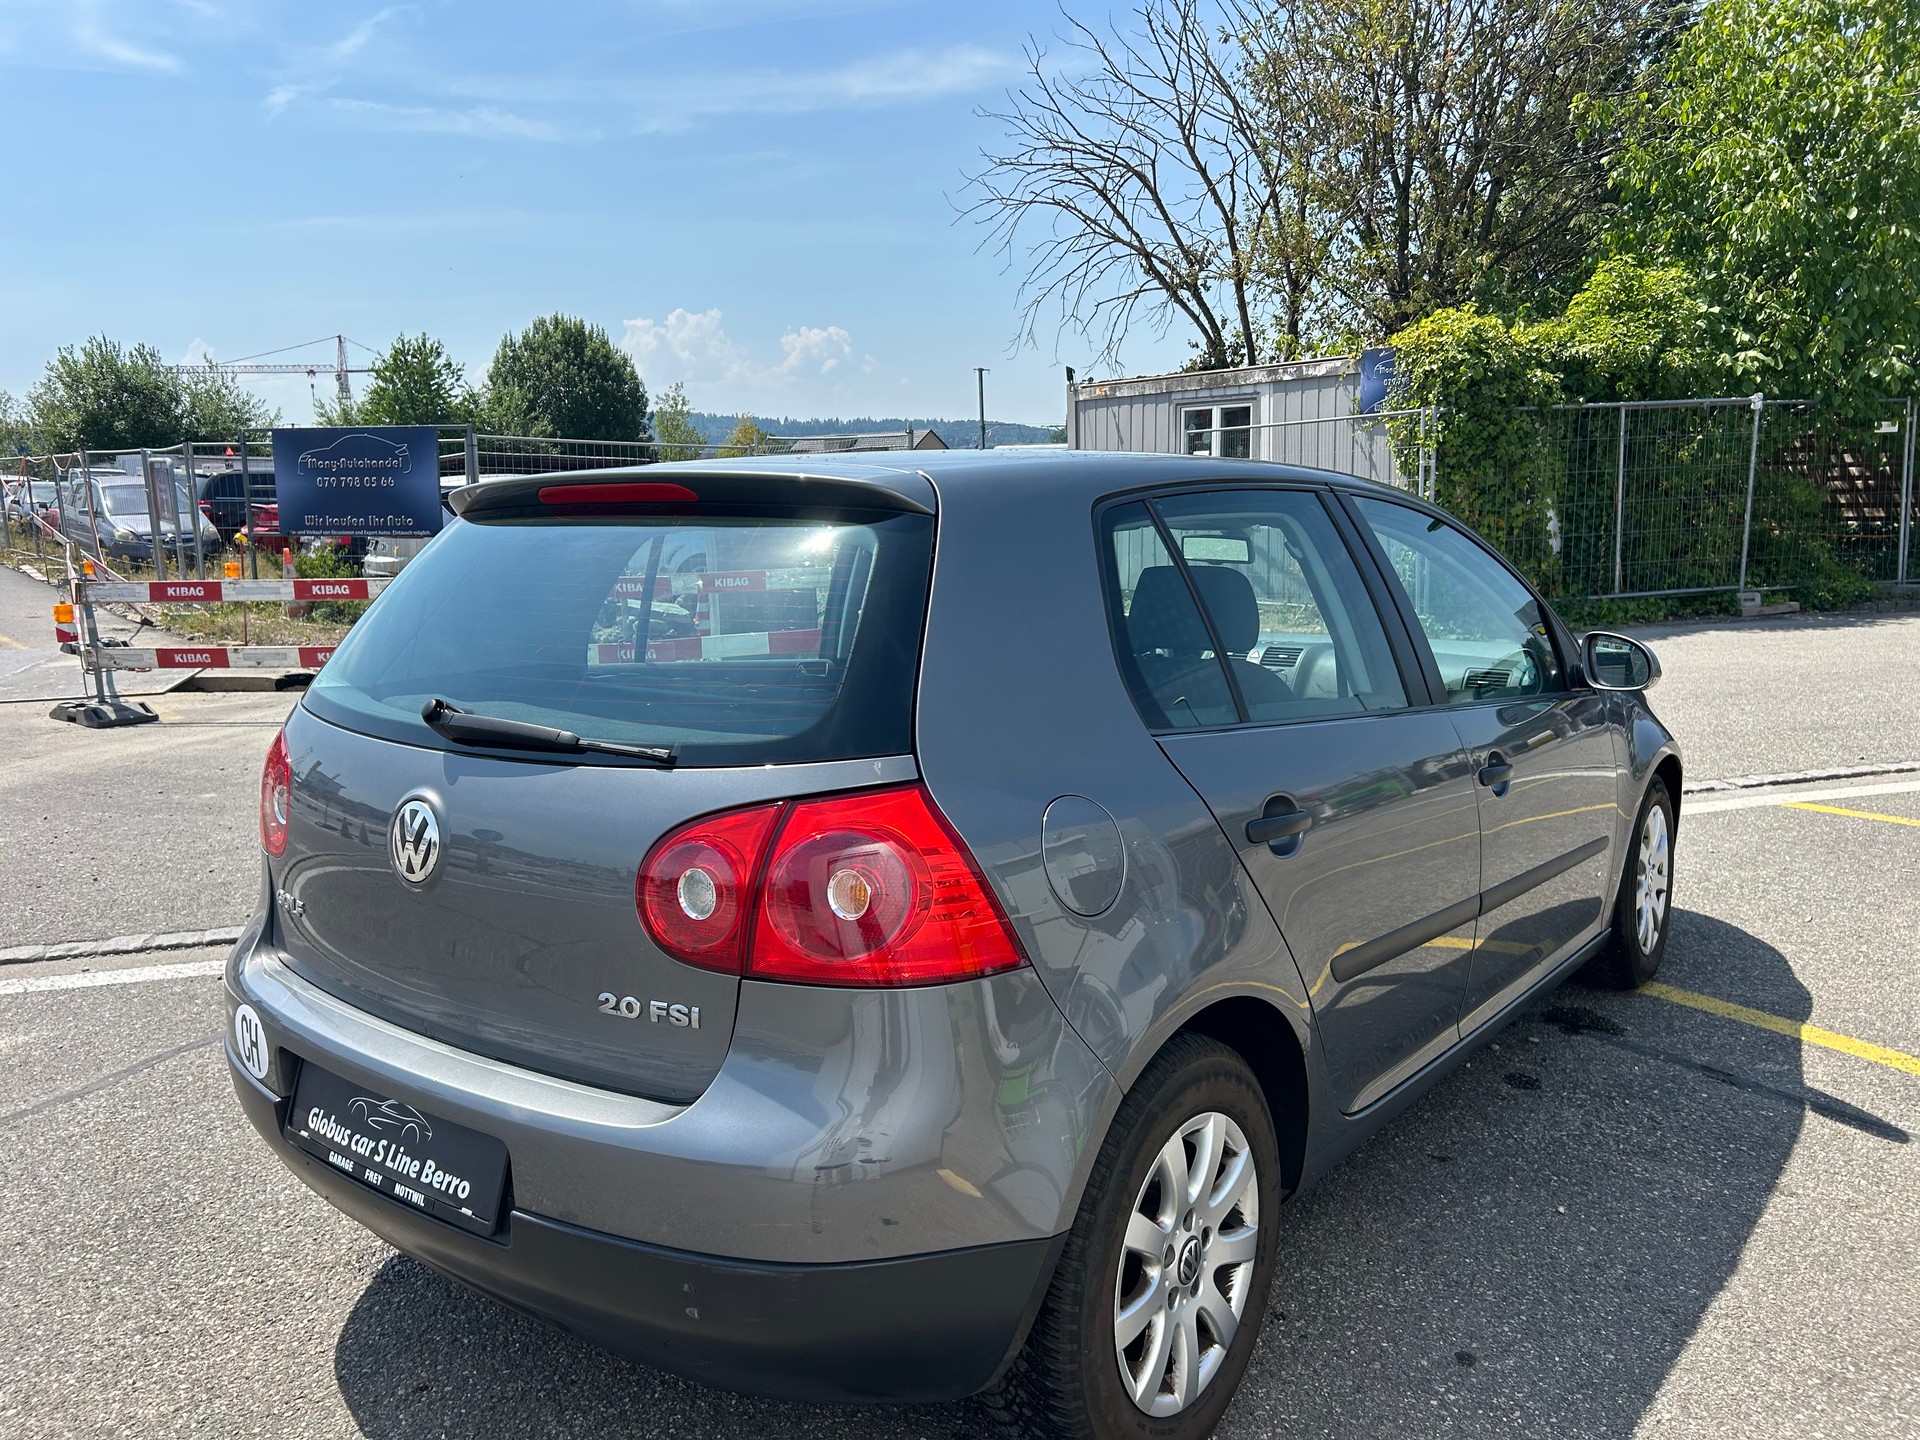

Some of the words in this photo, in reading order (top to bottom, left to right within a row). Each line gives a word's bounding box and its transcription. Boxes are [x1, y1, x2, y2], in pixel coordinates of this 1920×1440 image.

[307, 457, 402, 472] Mony-Autohandel
[316, 476, 336, 488] 079
[341, 476, 361, 488] 798
[364, 476, 377, 488] 05
[380, 476, 395, 488] 66
[304, 514, 323, 527] Wir
[325, 514, 365, 527] kaufen
[368, 514, 384, 527] Ihr
[387, 514, 414, 527] Auto
[615, 582, 644, 593] KIBA
[714, 576, 749, 588] KIBAG
[167, 586, 205, 597] KIBAG
[311, 584, 350, 596] KIBAG
[173, 652, 212, 664] KIBAG
[649, 999, 701, 1030] FSI
[240, 1013, 262, 1073] CH
[307, 1106, 353, 1146] Globus
[350, 1132, 376, 1158] car
[373, 1138, 388, 1163] S
[384, 1143, 421, 1179] Line
[419, 1159, 472, 1200] Berro
[328, 1150, 355, 1173] GARAGE
[364, 1168, 384, 1187] FREY
[394, 1182, 426, 1207] NOTTWIL
